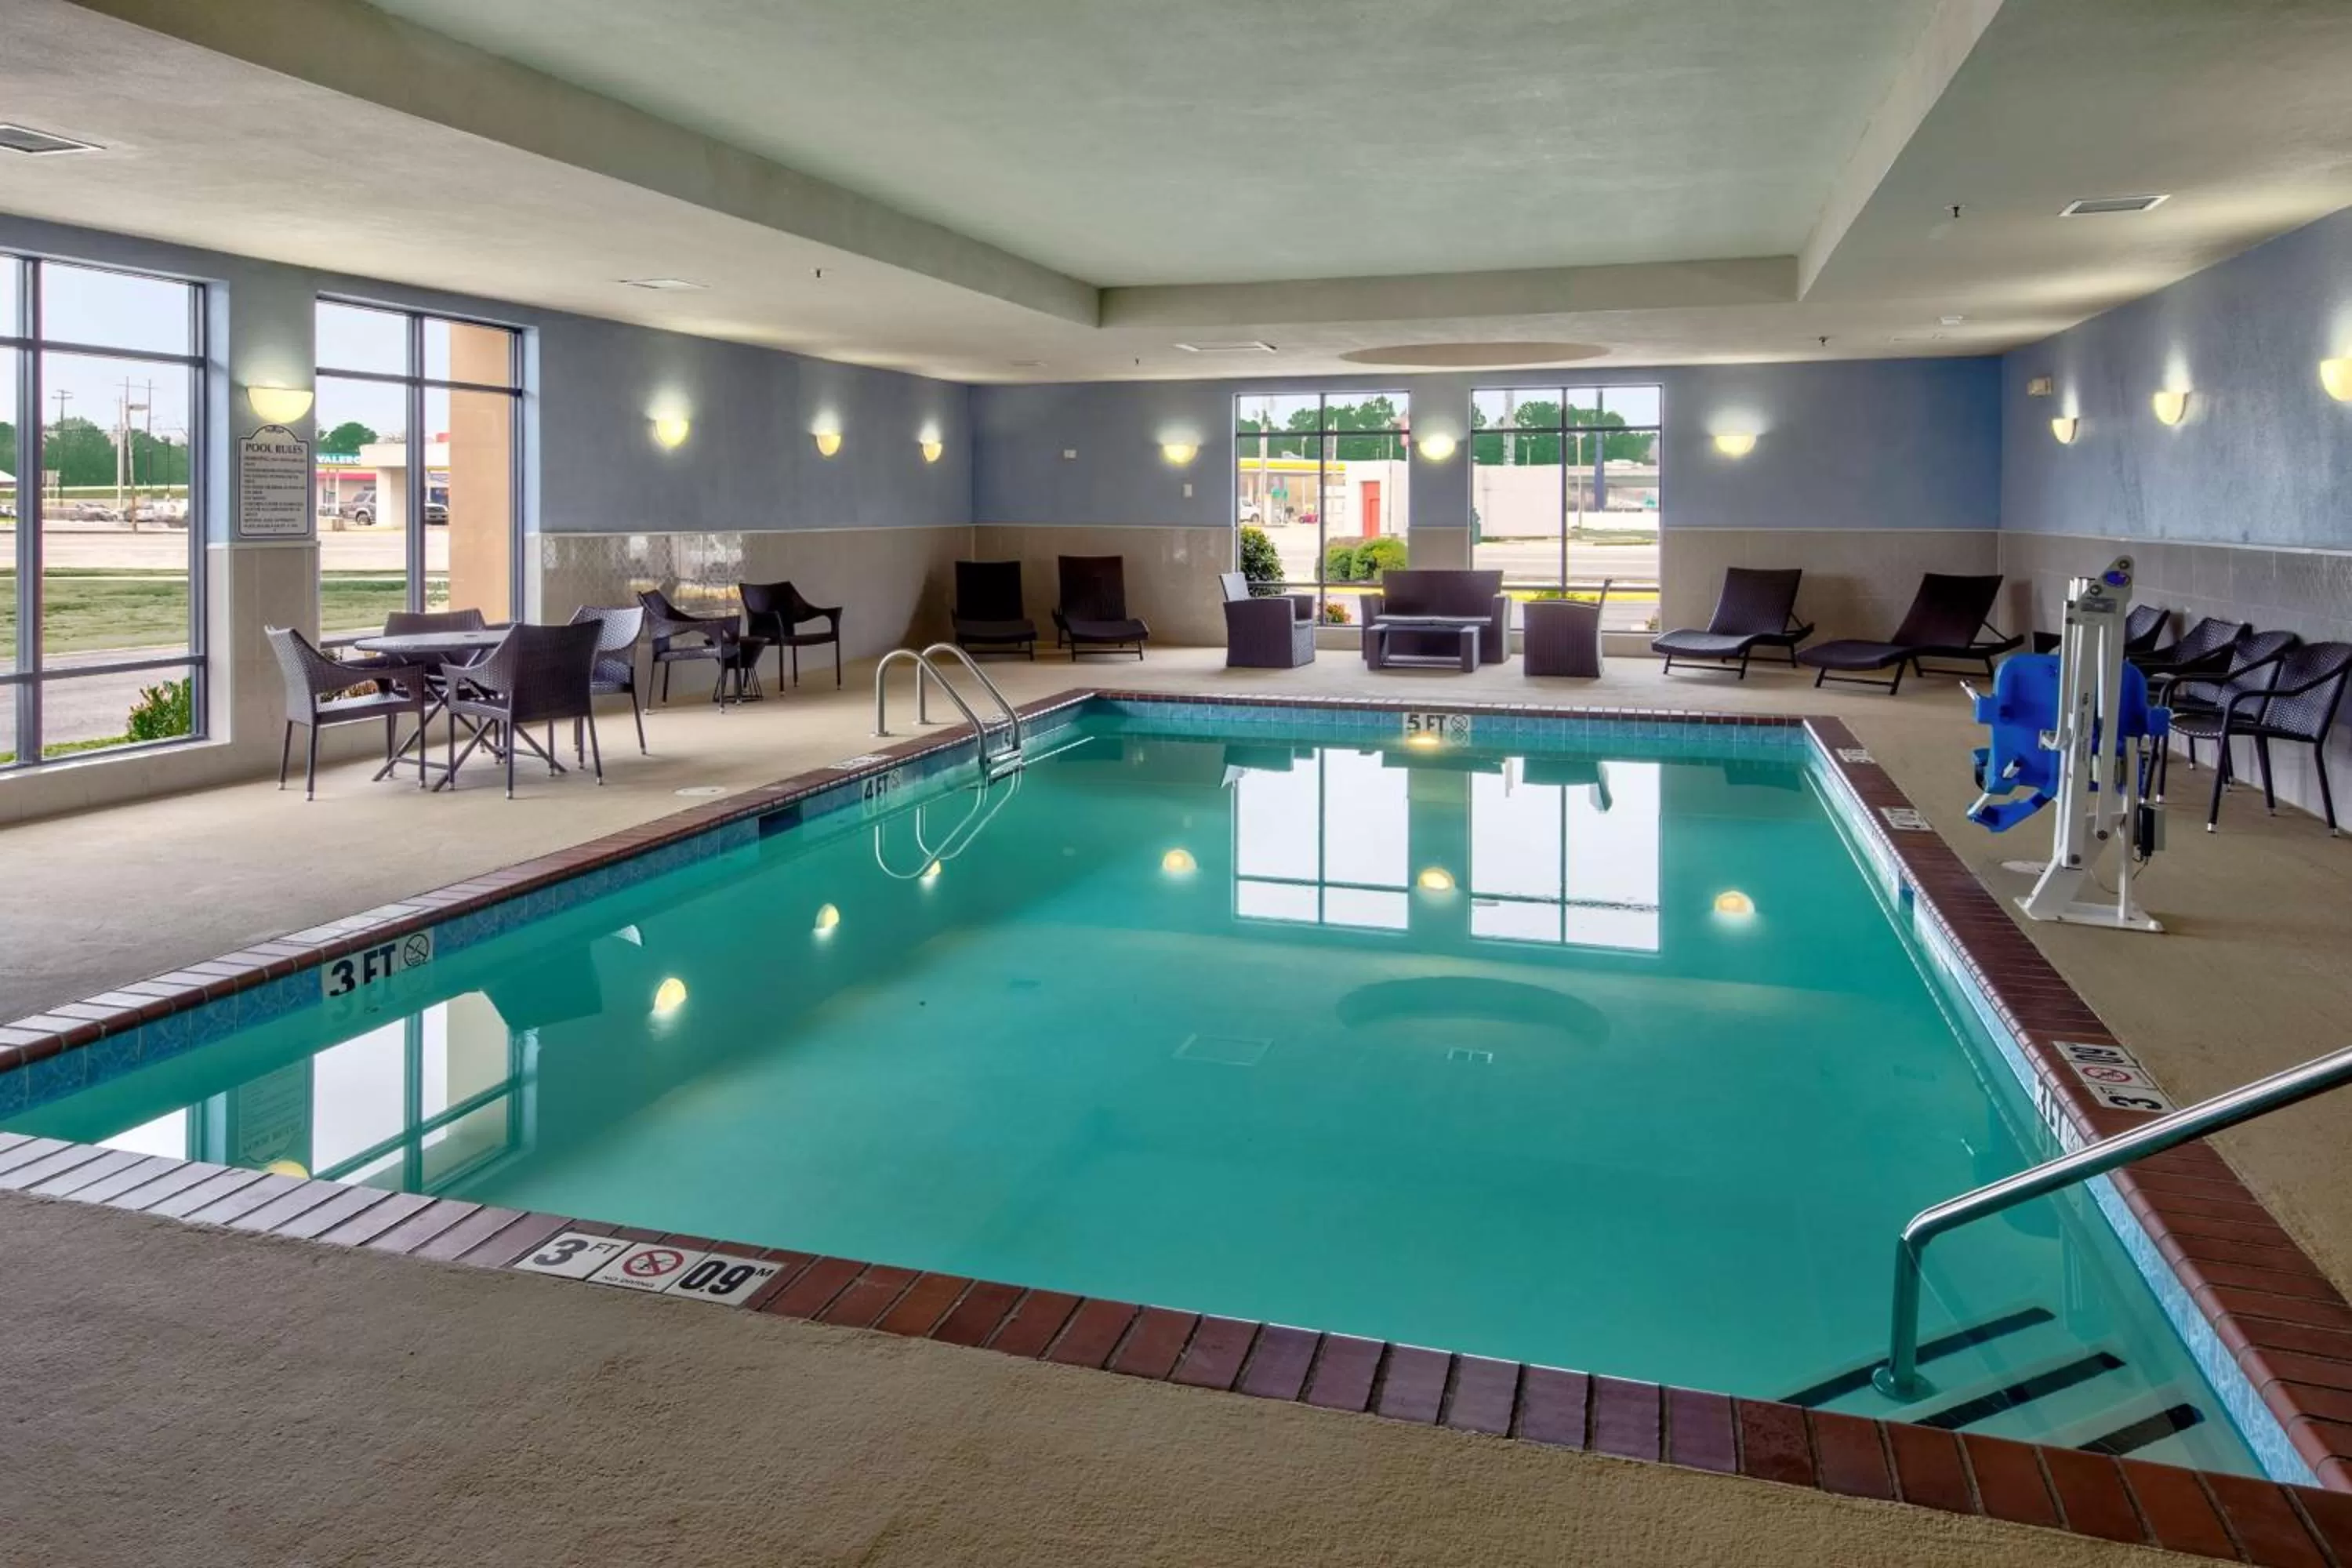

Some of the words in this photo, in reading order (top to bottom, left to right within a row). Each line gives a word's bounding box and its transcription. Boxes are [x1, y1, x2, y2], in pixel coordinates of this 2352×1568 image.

[245, 443, 272, 452] POOL
[1407, 714, 1421, 731] 5
[1427, 715, 1446, 734] FT
[865, 780, 874, 799] 4
[329, 960, 356, 996] 3
[363, 944, 396, 985] FT
[534, 1239, 588, 1265] 3
[587, 1242, 620, 1254] FT
[678, 1260, 756, 1295] 0.9
[756, 1268, 775, 1276] M
